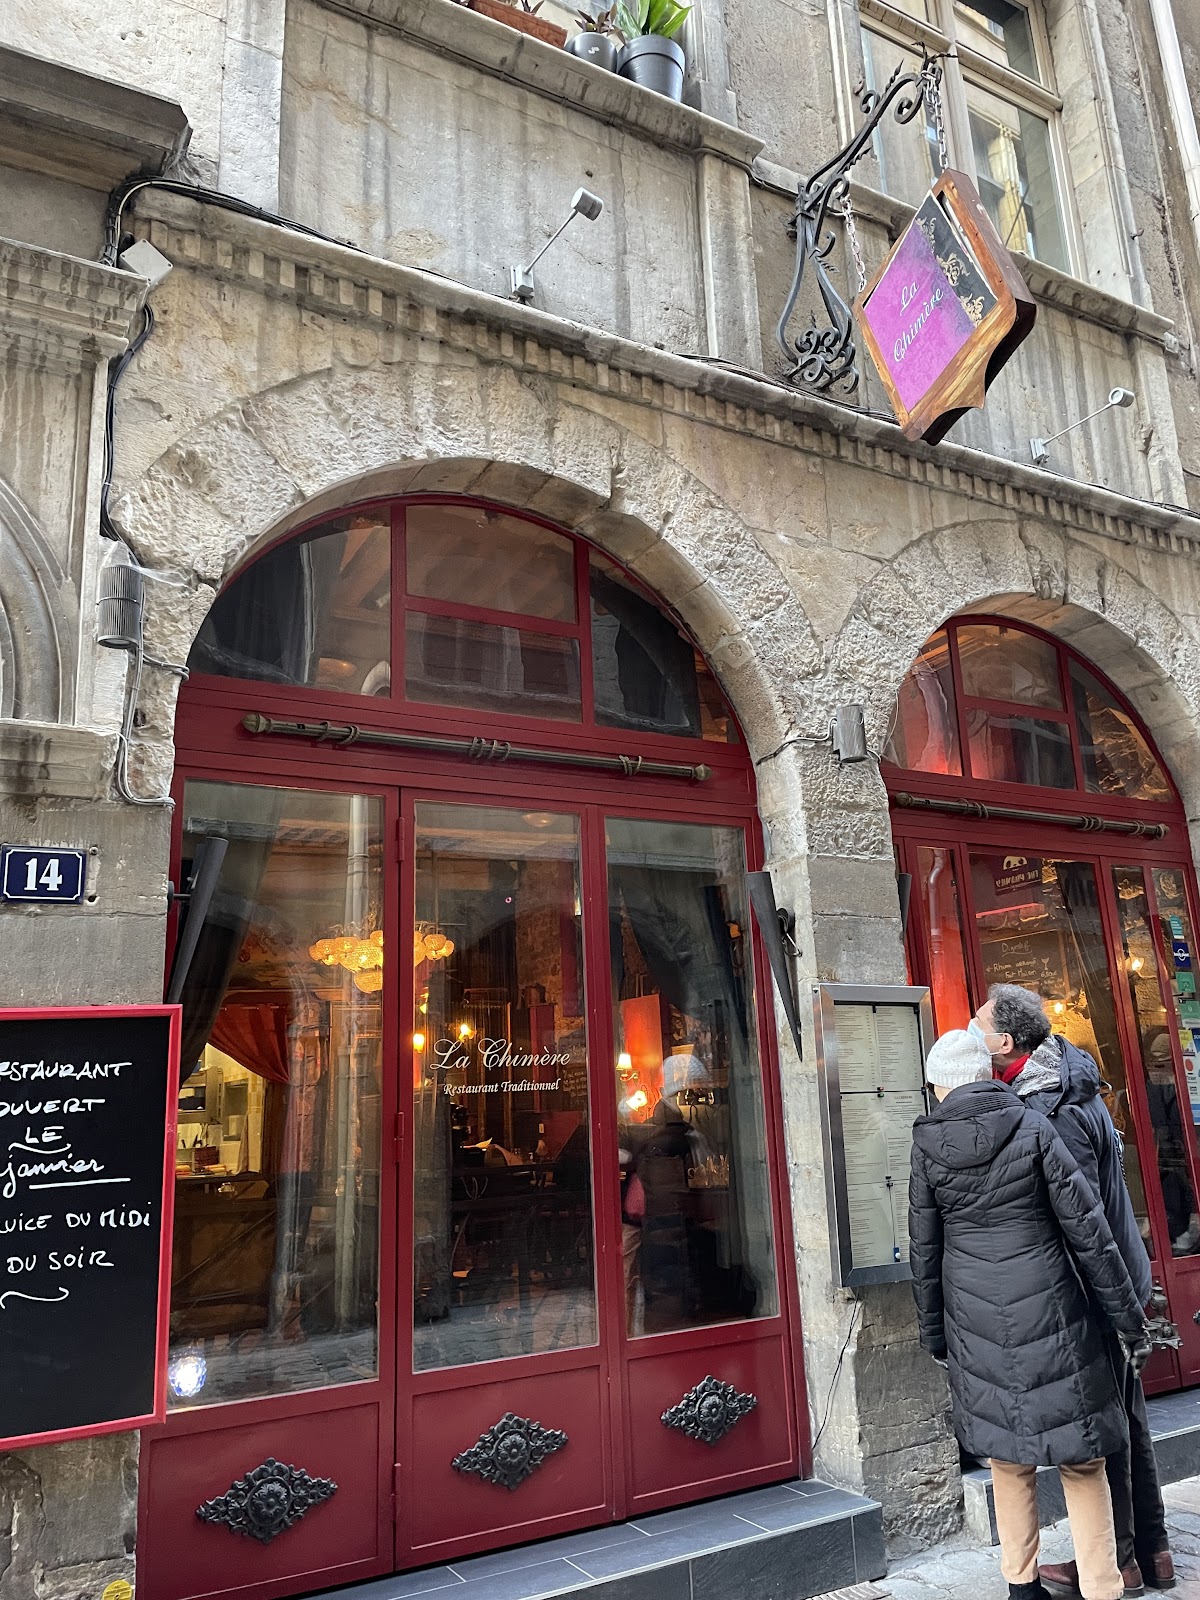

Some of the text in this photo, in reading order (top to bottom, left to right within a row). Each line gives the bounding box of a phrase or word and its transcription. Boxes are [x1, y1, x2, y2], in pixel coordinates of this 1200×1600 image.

[899, 282, 920, 316] La
[894, 288, 943, 362] Chimère
[23, 857, 63, 891] 14
[429, 1038, 471, 1070] La
[477, 1037, 571, 1071] Chimère
[0, 1060, 133, 1081] ESTAURANT
[443, 1082, 499, 1095] Restaurant
[500, 1078, 562, 1093] Traditionnel
[25, 1126, 65, 1144] LE
[0, 1153, 105, 1198] janvier
[65, 1212, 91, 1228] DU
[100, 1201, 152, 1229] MIDI
[6, 1246, 115, 1274] DU SOIR
